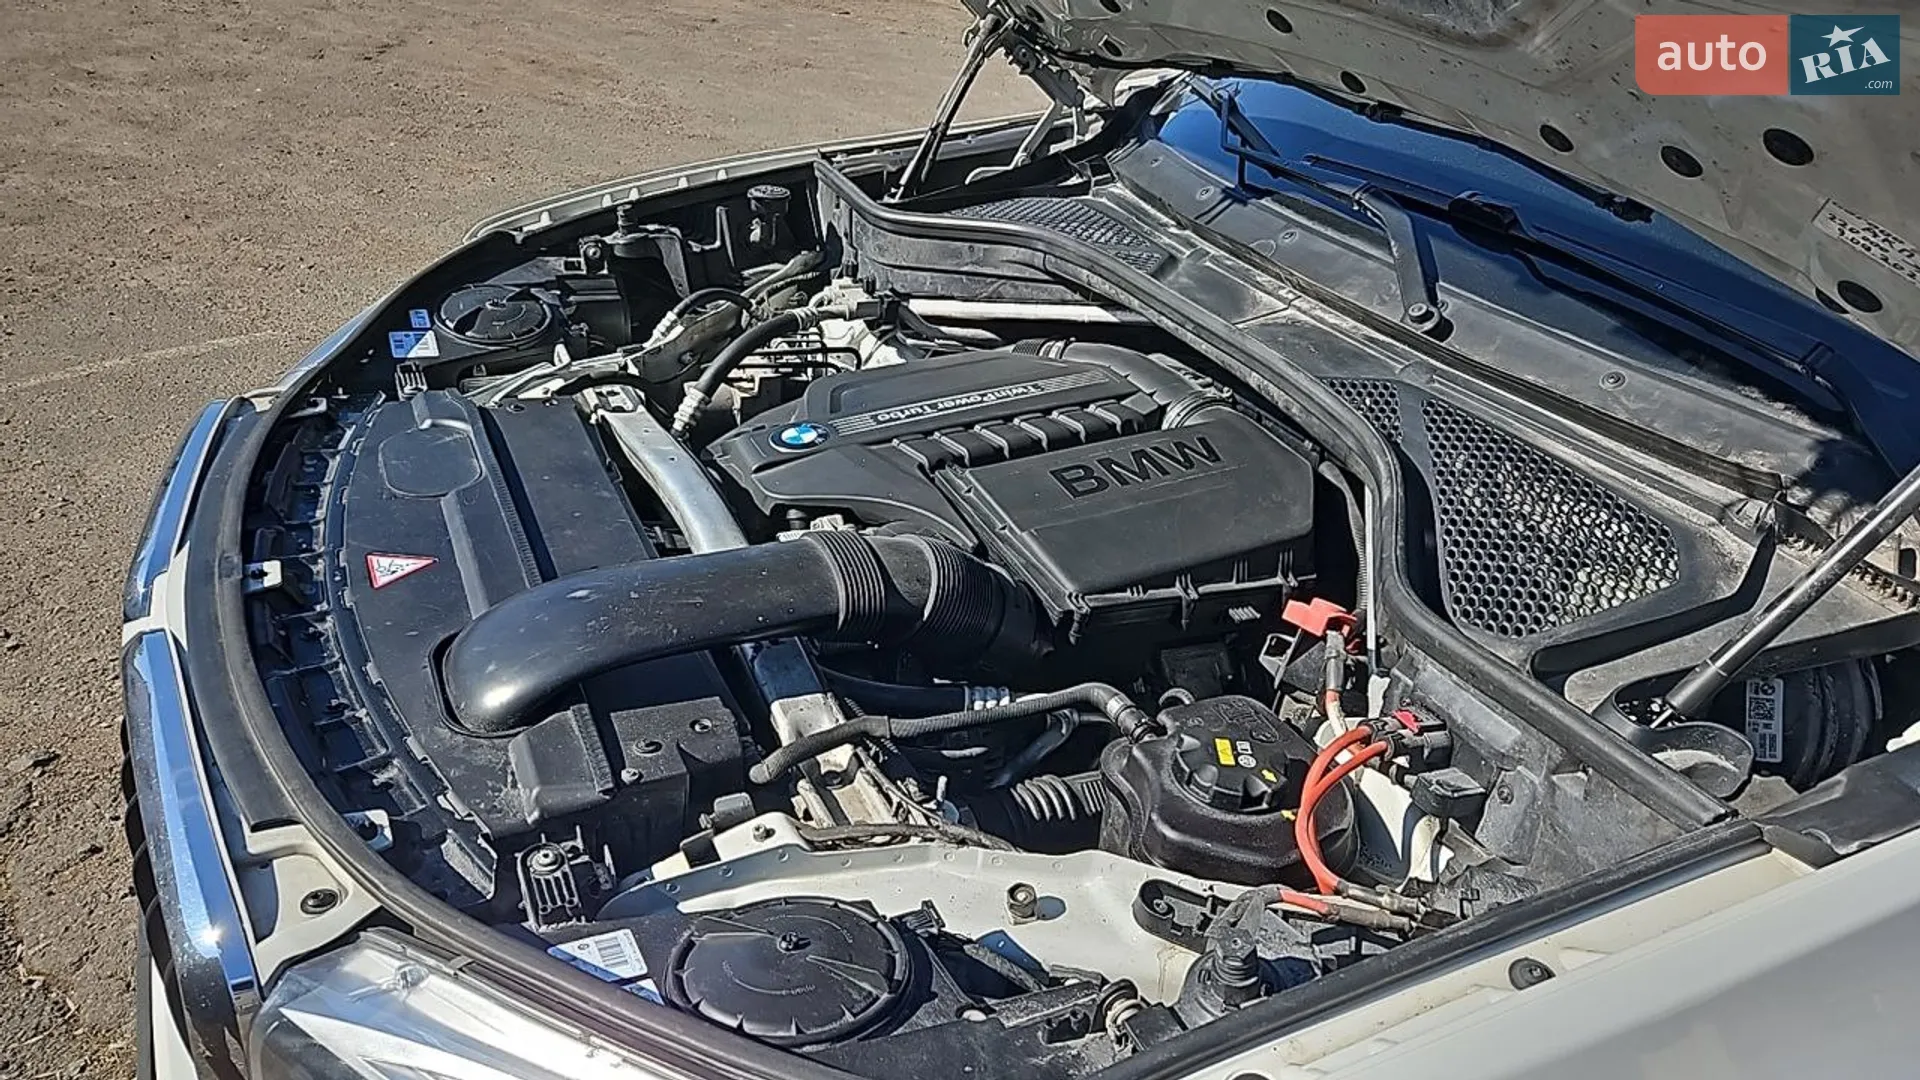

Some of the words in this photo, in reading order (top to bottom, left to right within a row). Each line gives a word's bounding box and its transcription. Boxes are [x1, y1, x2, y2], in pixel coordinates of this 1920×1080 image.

[937, 383, 1039, 411] TwinPower
[877, 403, 937, 422] Turbo
[1048, 435, 1225, 499] BMW
